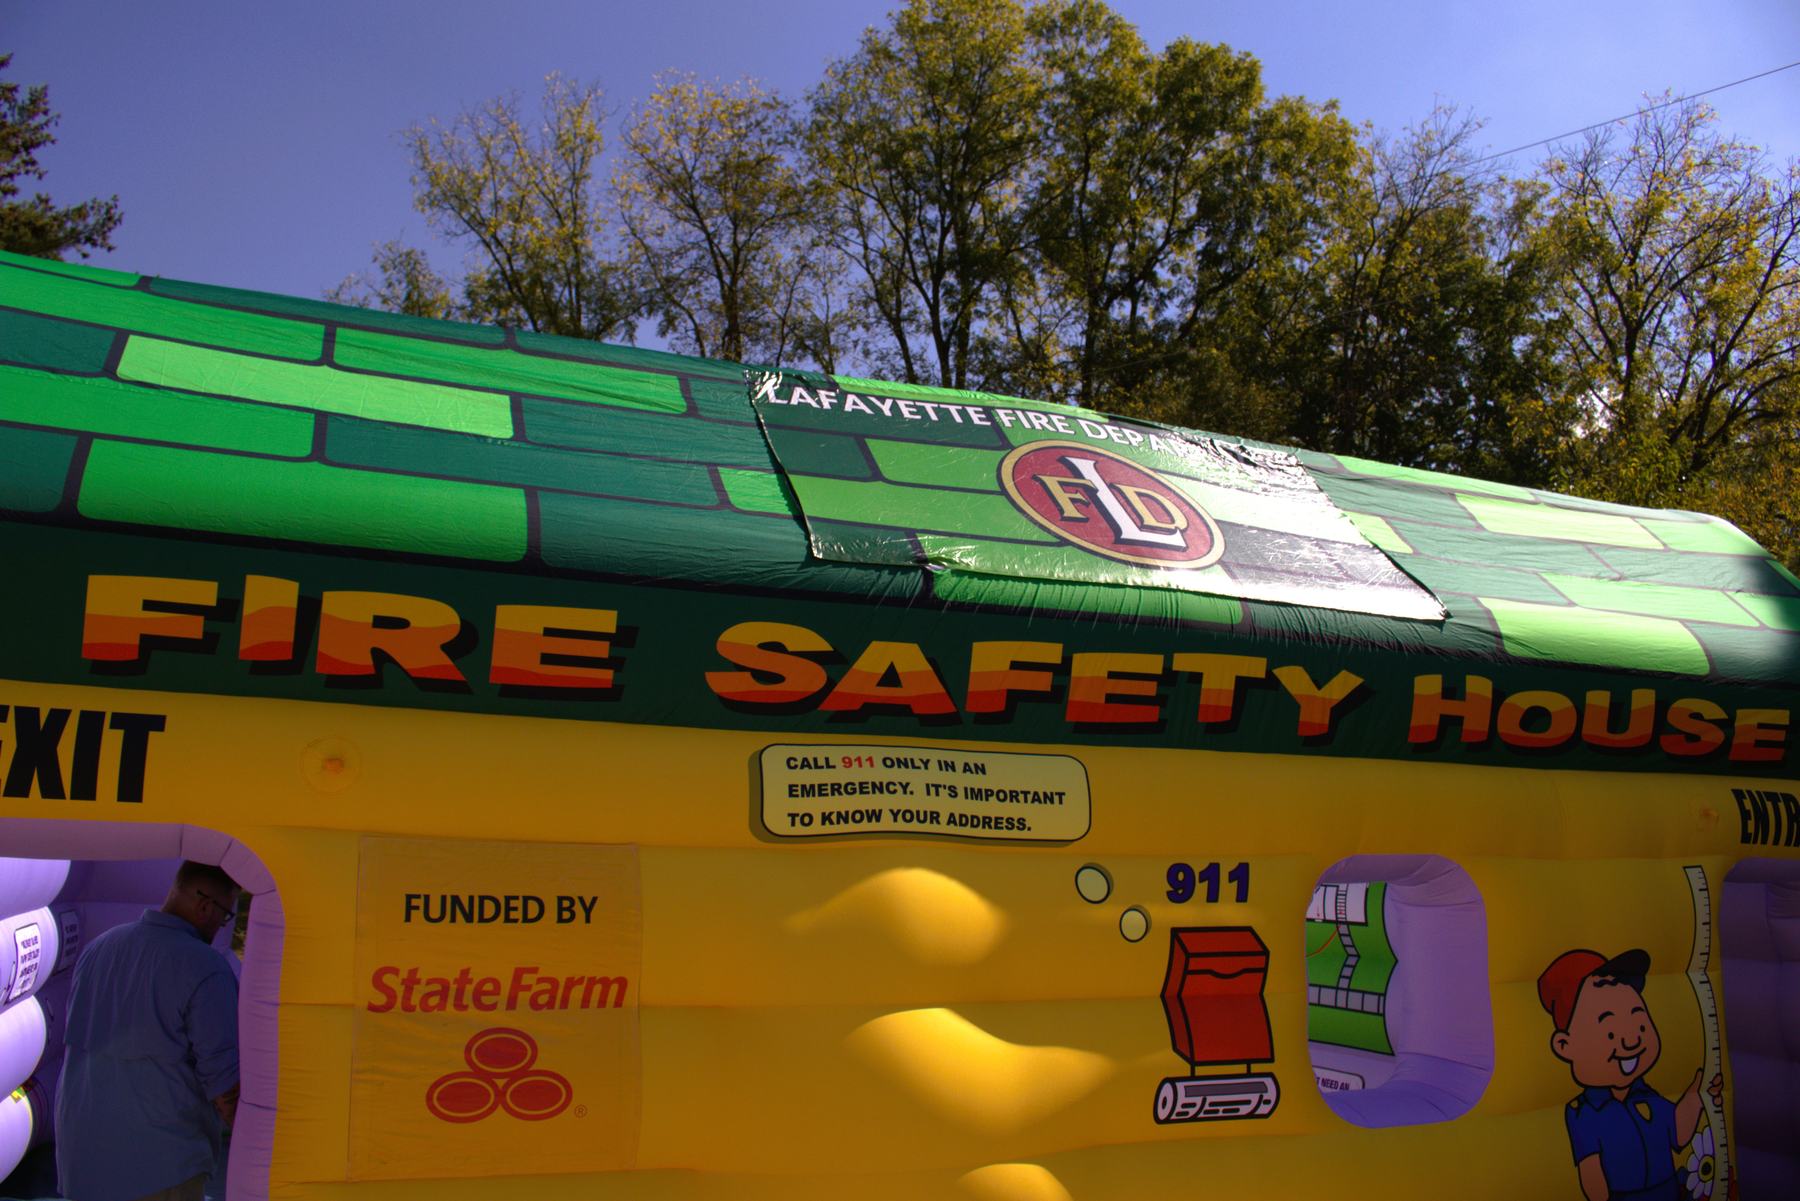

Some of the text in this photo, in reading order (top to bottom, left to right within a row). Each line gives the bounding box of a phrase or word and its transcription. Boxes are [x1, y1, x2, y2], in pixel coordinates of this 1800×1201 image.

[765, 380, 991, 426] LAFAYETTE
[994, 408, 1075, 435] FIRE
[82, 574, 1790, 761] FIRE SAFETY HOUSE
[786, 755, 987, 776] CALL 911 ONLY IN AN
[787, 781, 1066, 805] EMERGENCY. IT'S IMPORTANT
[787, 809, 1032, 832] TO KNOW YOUR ADDRESS.
[1166, 862, 1250, 904] 911
[403, 893, 599, 925] FUNDED BY
[1321, 1077, 1339, 1090] NEED
